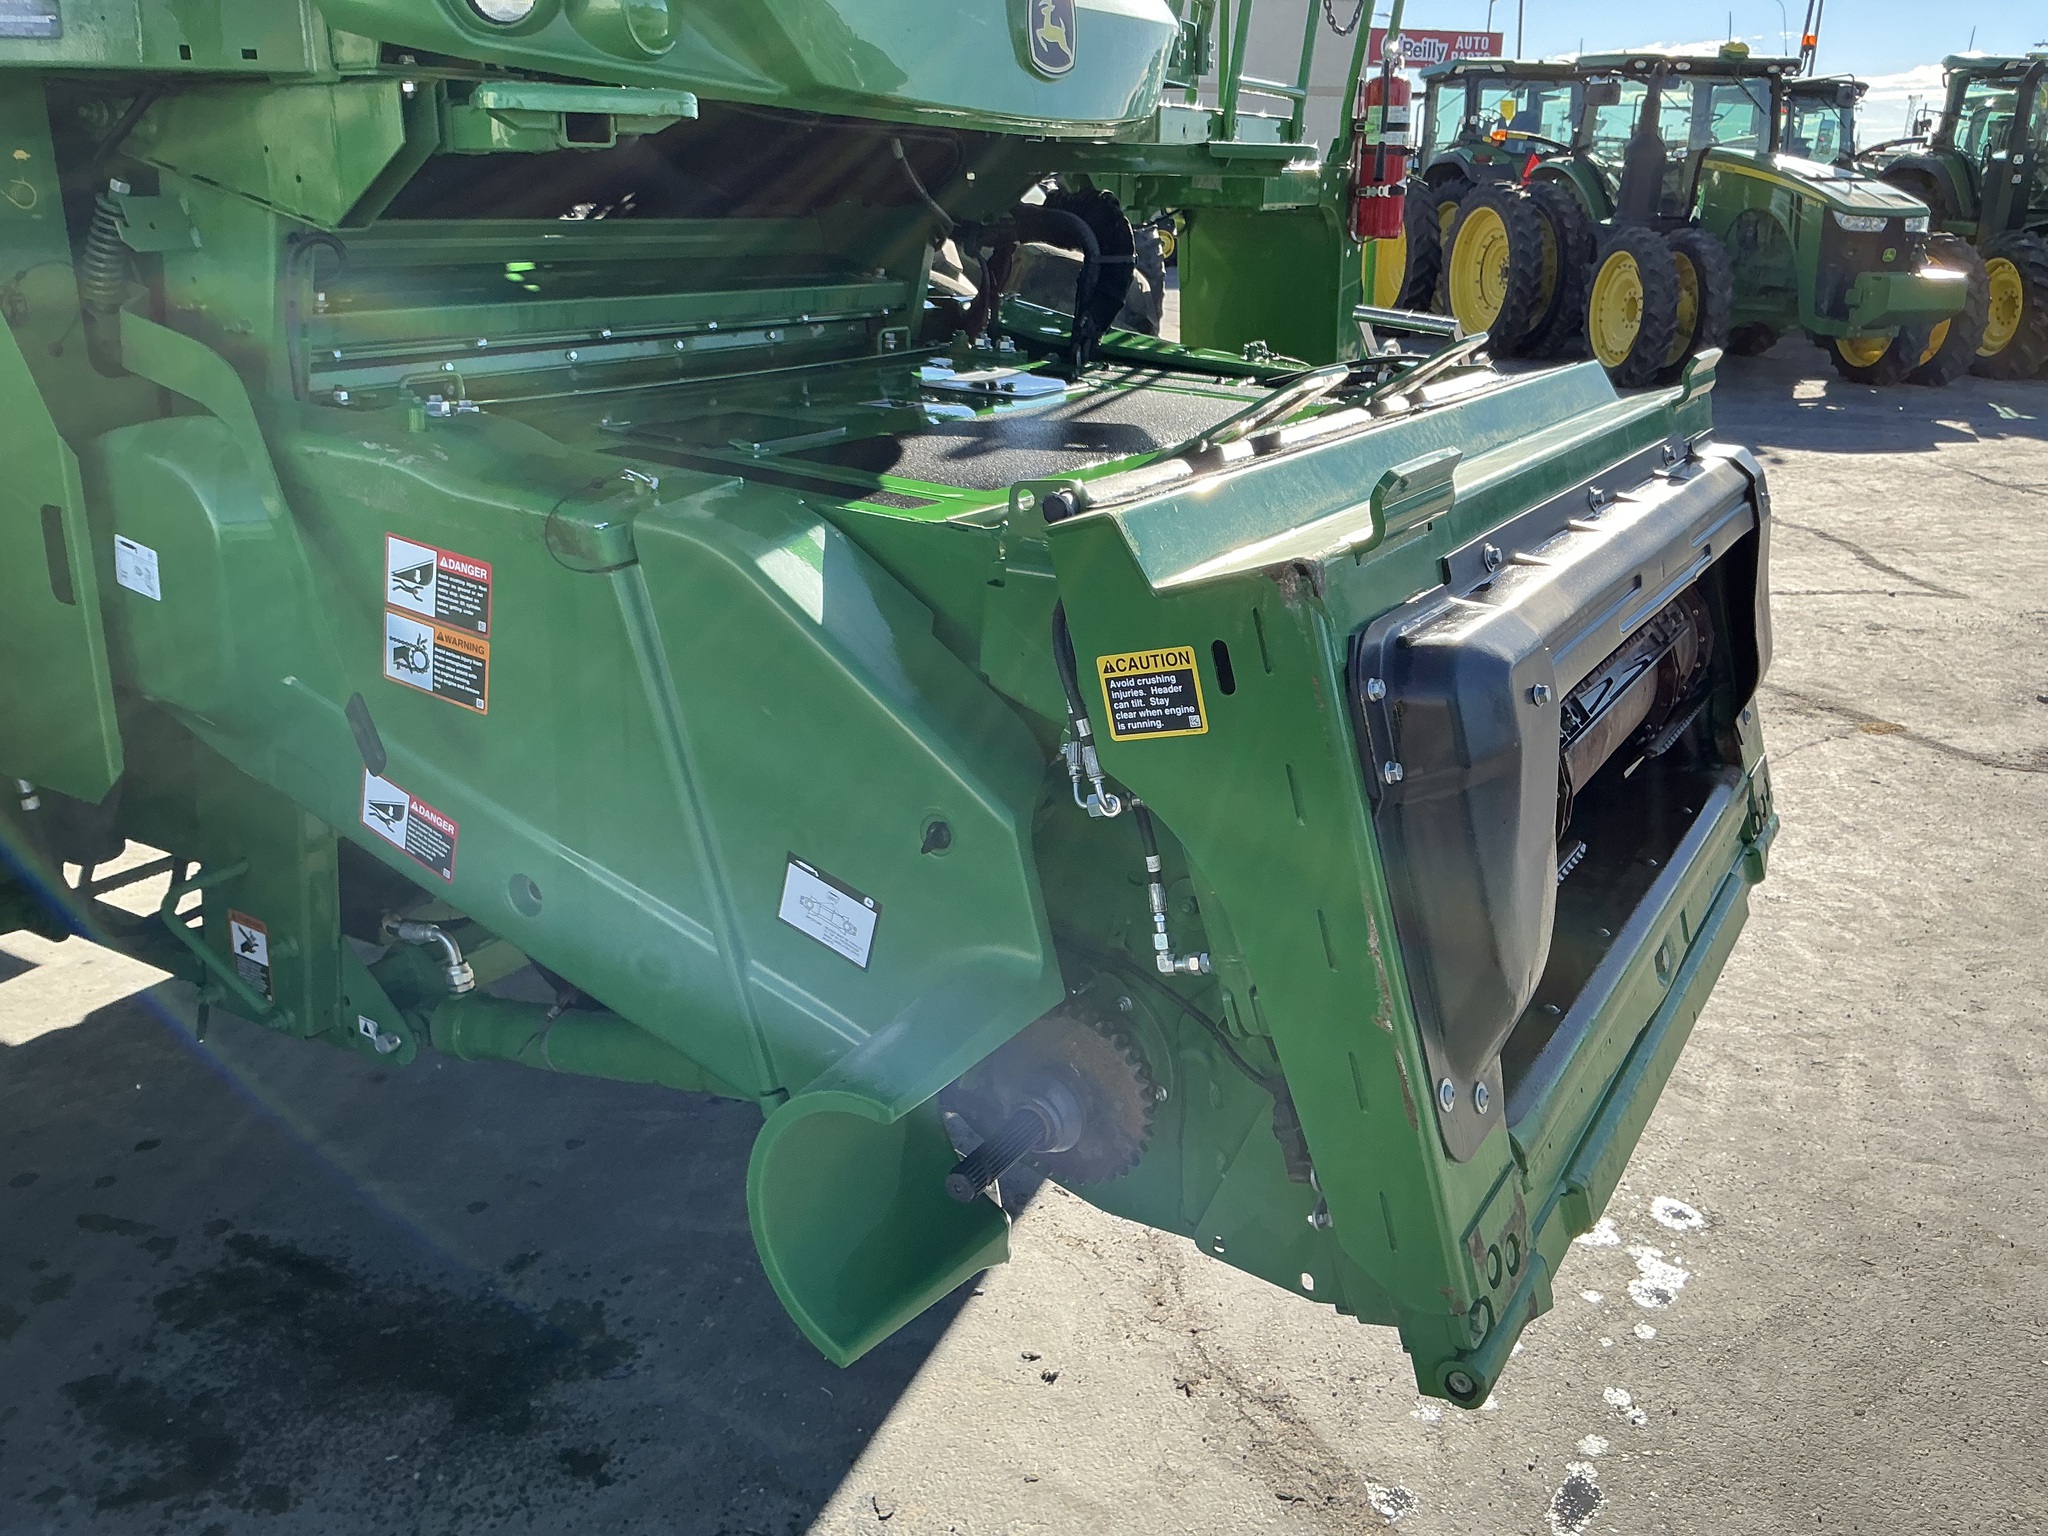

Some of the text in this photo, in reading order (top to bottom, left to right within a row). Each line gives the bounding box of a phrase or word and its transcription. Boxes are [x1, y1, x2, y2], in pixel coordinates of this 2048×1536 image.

[1382, 34, 1447, 62] 'Reilly
[1455, 36, 1489, 50] AUTO
[448, 559, 487, 580] DANGER
[444, 637, 485, 655] WARNING
[1116, 651, 1190, 672] CAUTION
[1110, 674, 1176, 688] Avoid crushing
[1111, 684, 1182, 700] injuries. Header
[1113, 696, 1169, 709] can tilt. Stay
[1116, 705, 1195, 719] clear when engine
[1118, 719, 1164, 730] is running.
[418, 805, 455, 835] DANGER
